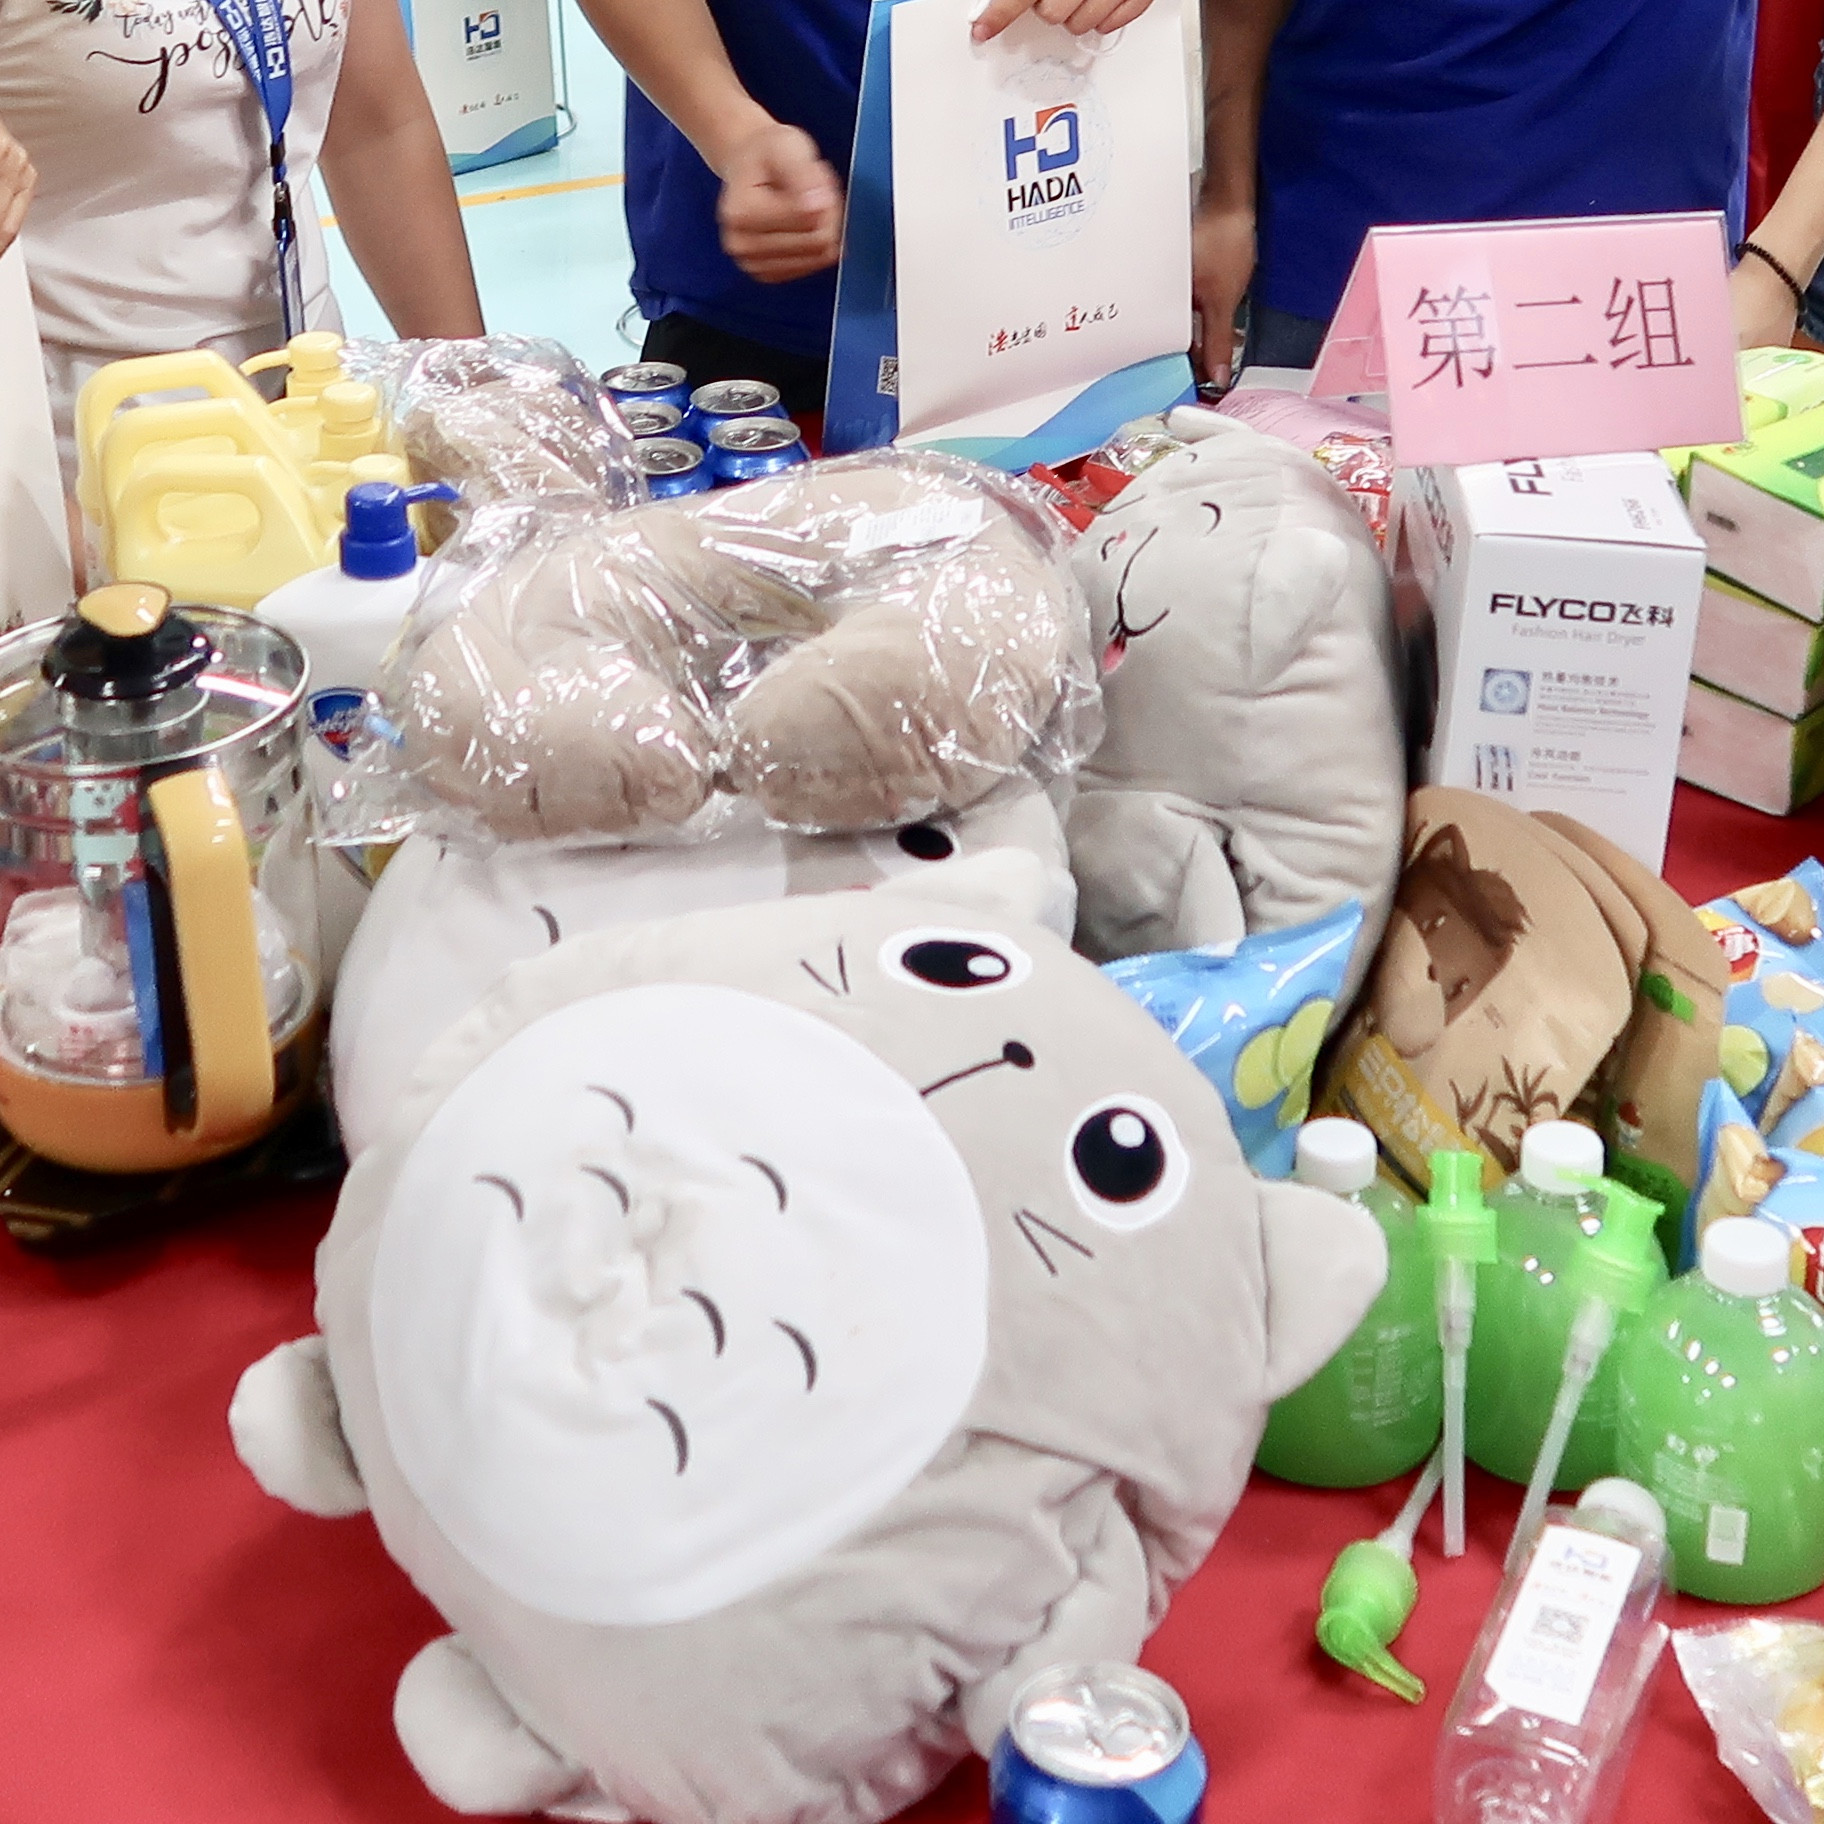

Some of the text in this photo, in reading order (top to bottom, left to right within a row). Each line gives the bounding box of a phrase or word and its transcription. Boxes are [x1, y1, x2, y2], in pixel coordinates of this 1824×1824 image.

[1007, 172, 1084, 213] HADA
[1407, 277, 1695, 389] 第二组
